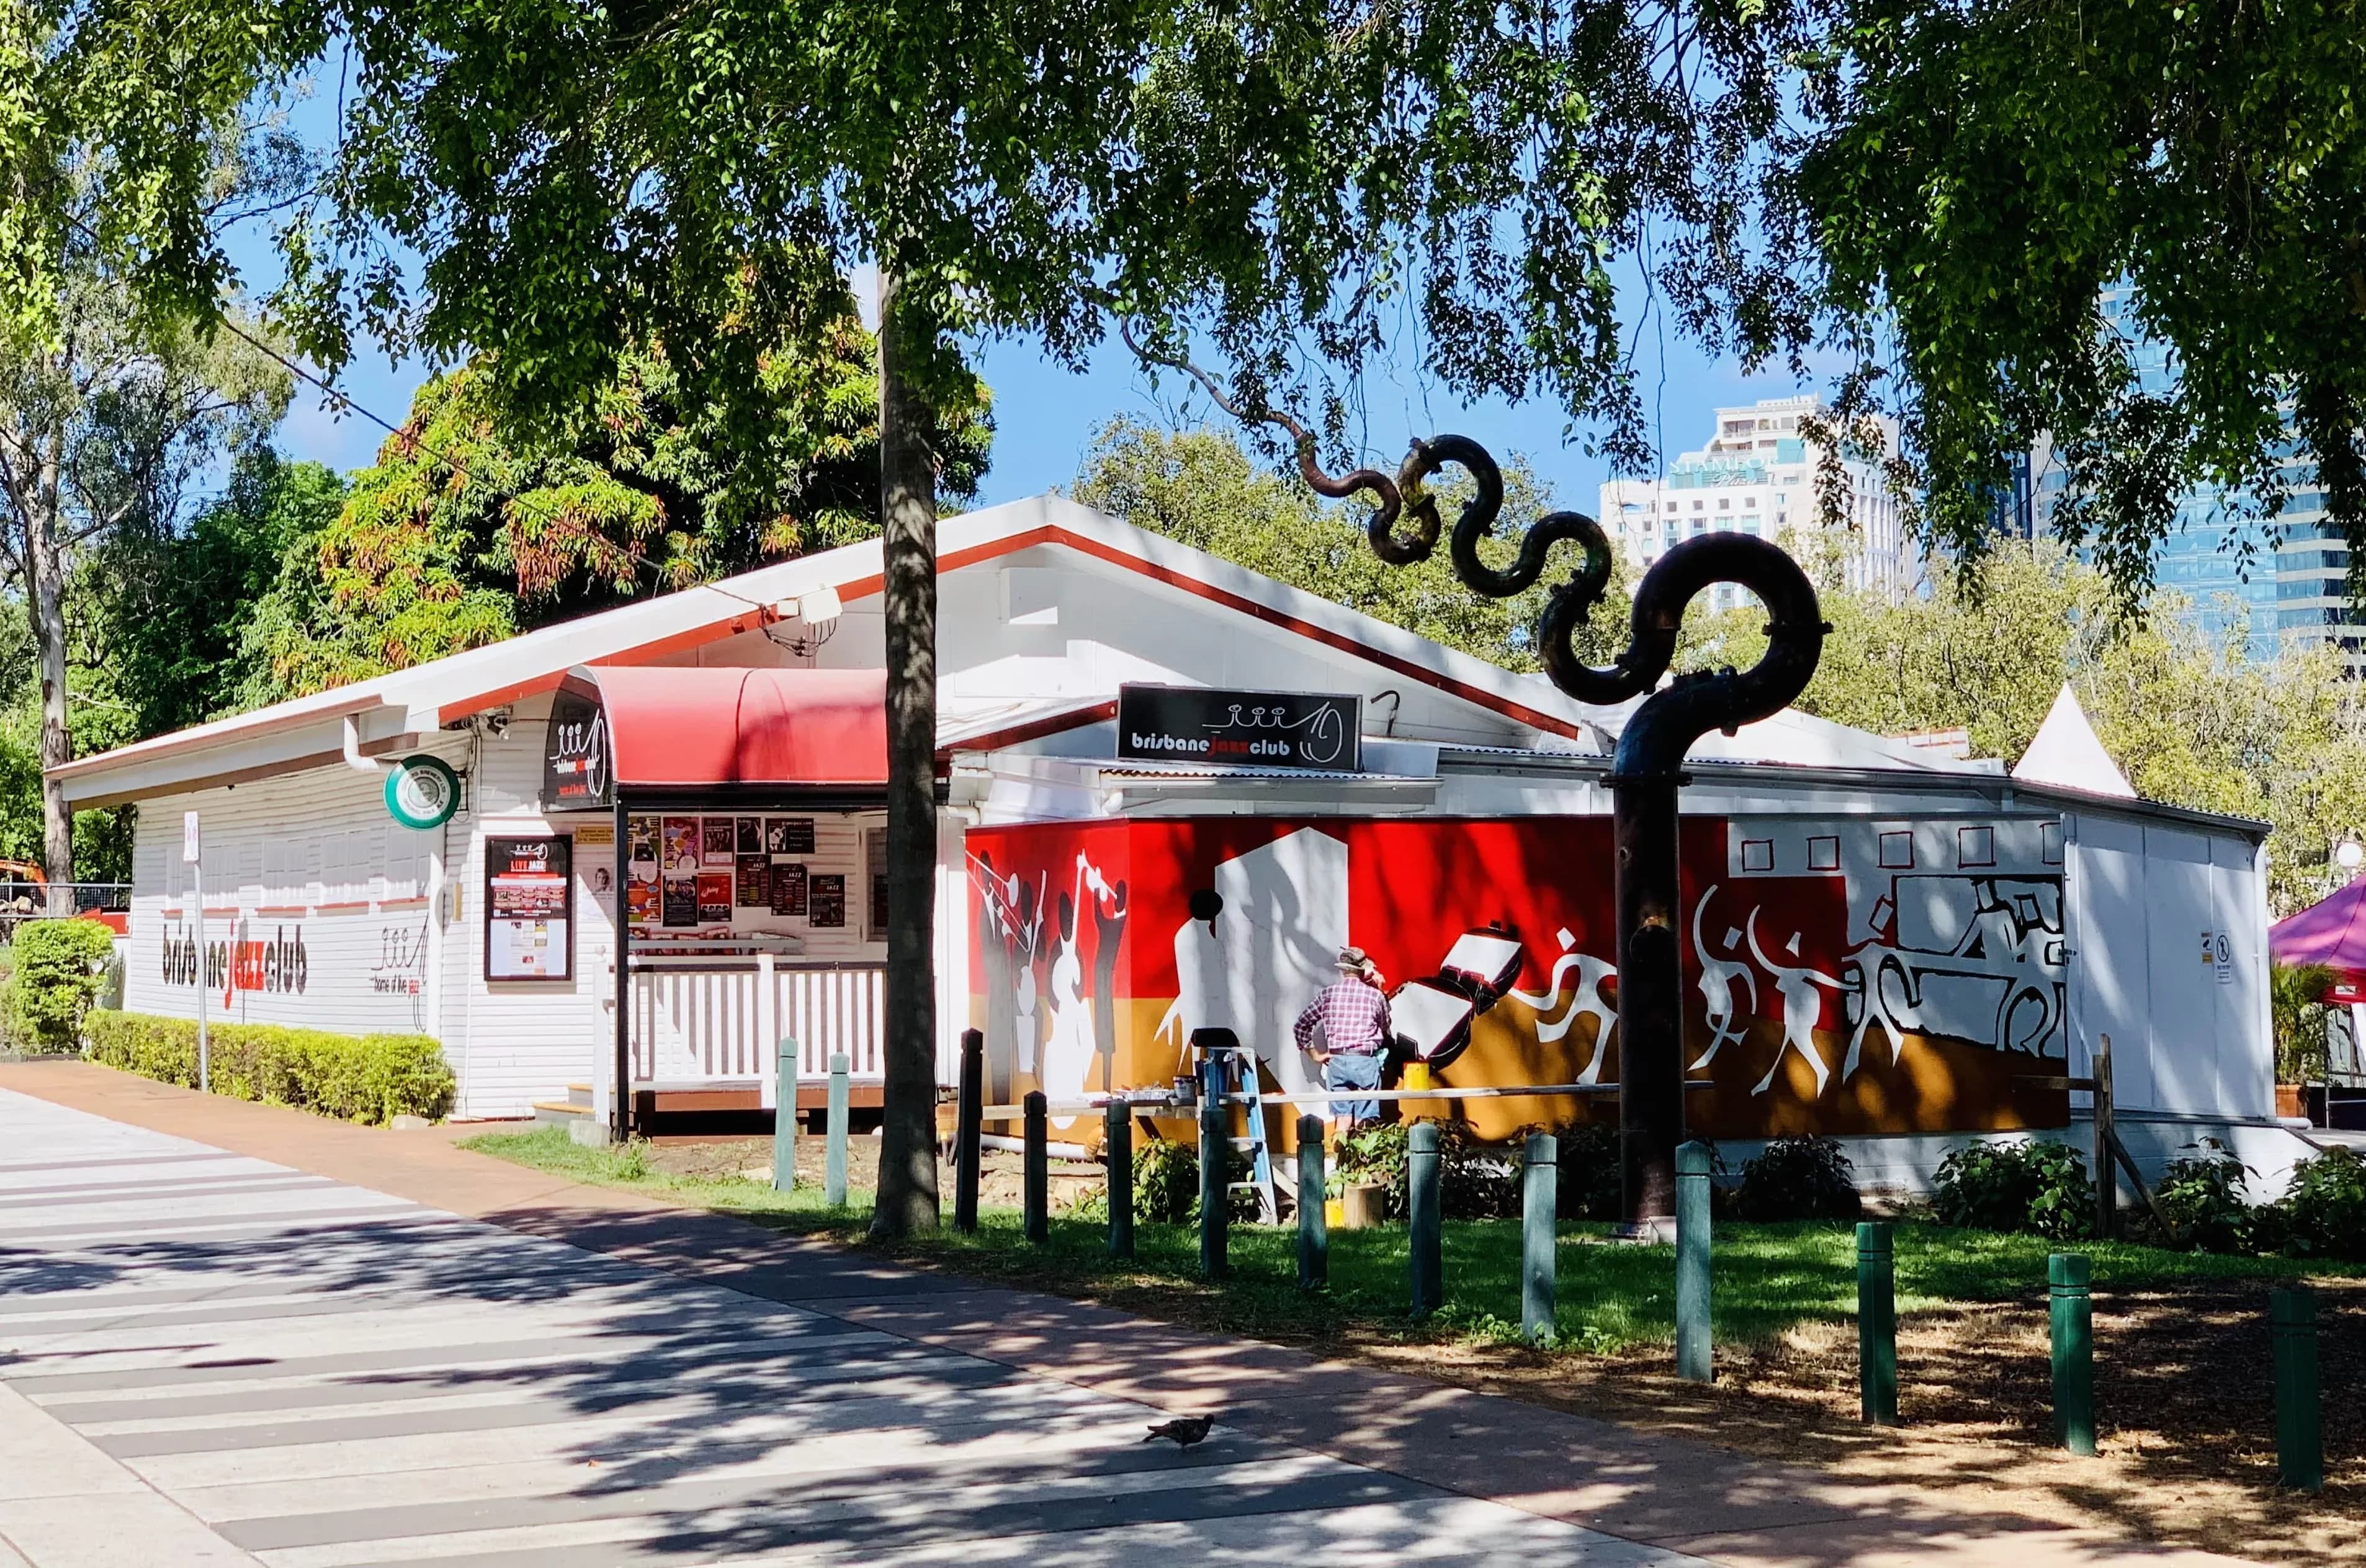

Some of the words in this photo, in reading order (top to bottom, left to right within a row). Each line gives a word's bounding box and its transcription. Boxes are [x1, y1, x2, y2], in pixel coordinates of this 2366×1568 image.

[1669, 456, 1779, 473] STAMFOR
[1132, 732, 1290, 757] brisbanejazzclub
[511, 860, 527, 869] LIVE
[163, 919, 307, 1010] brisbnejazzclub
[374, 974, 389, 993] home
